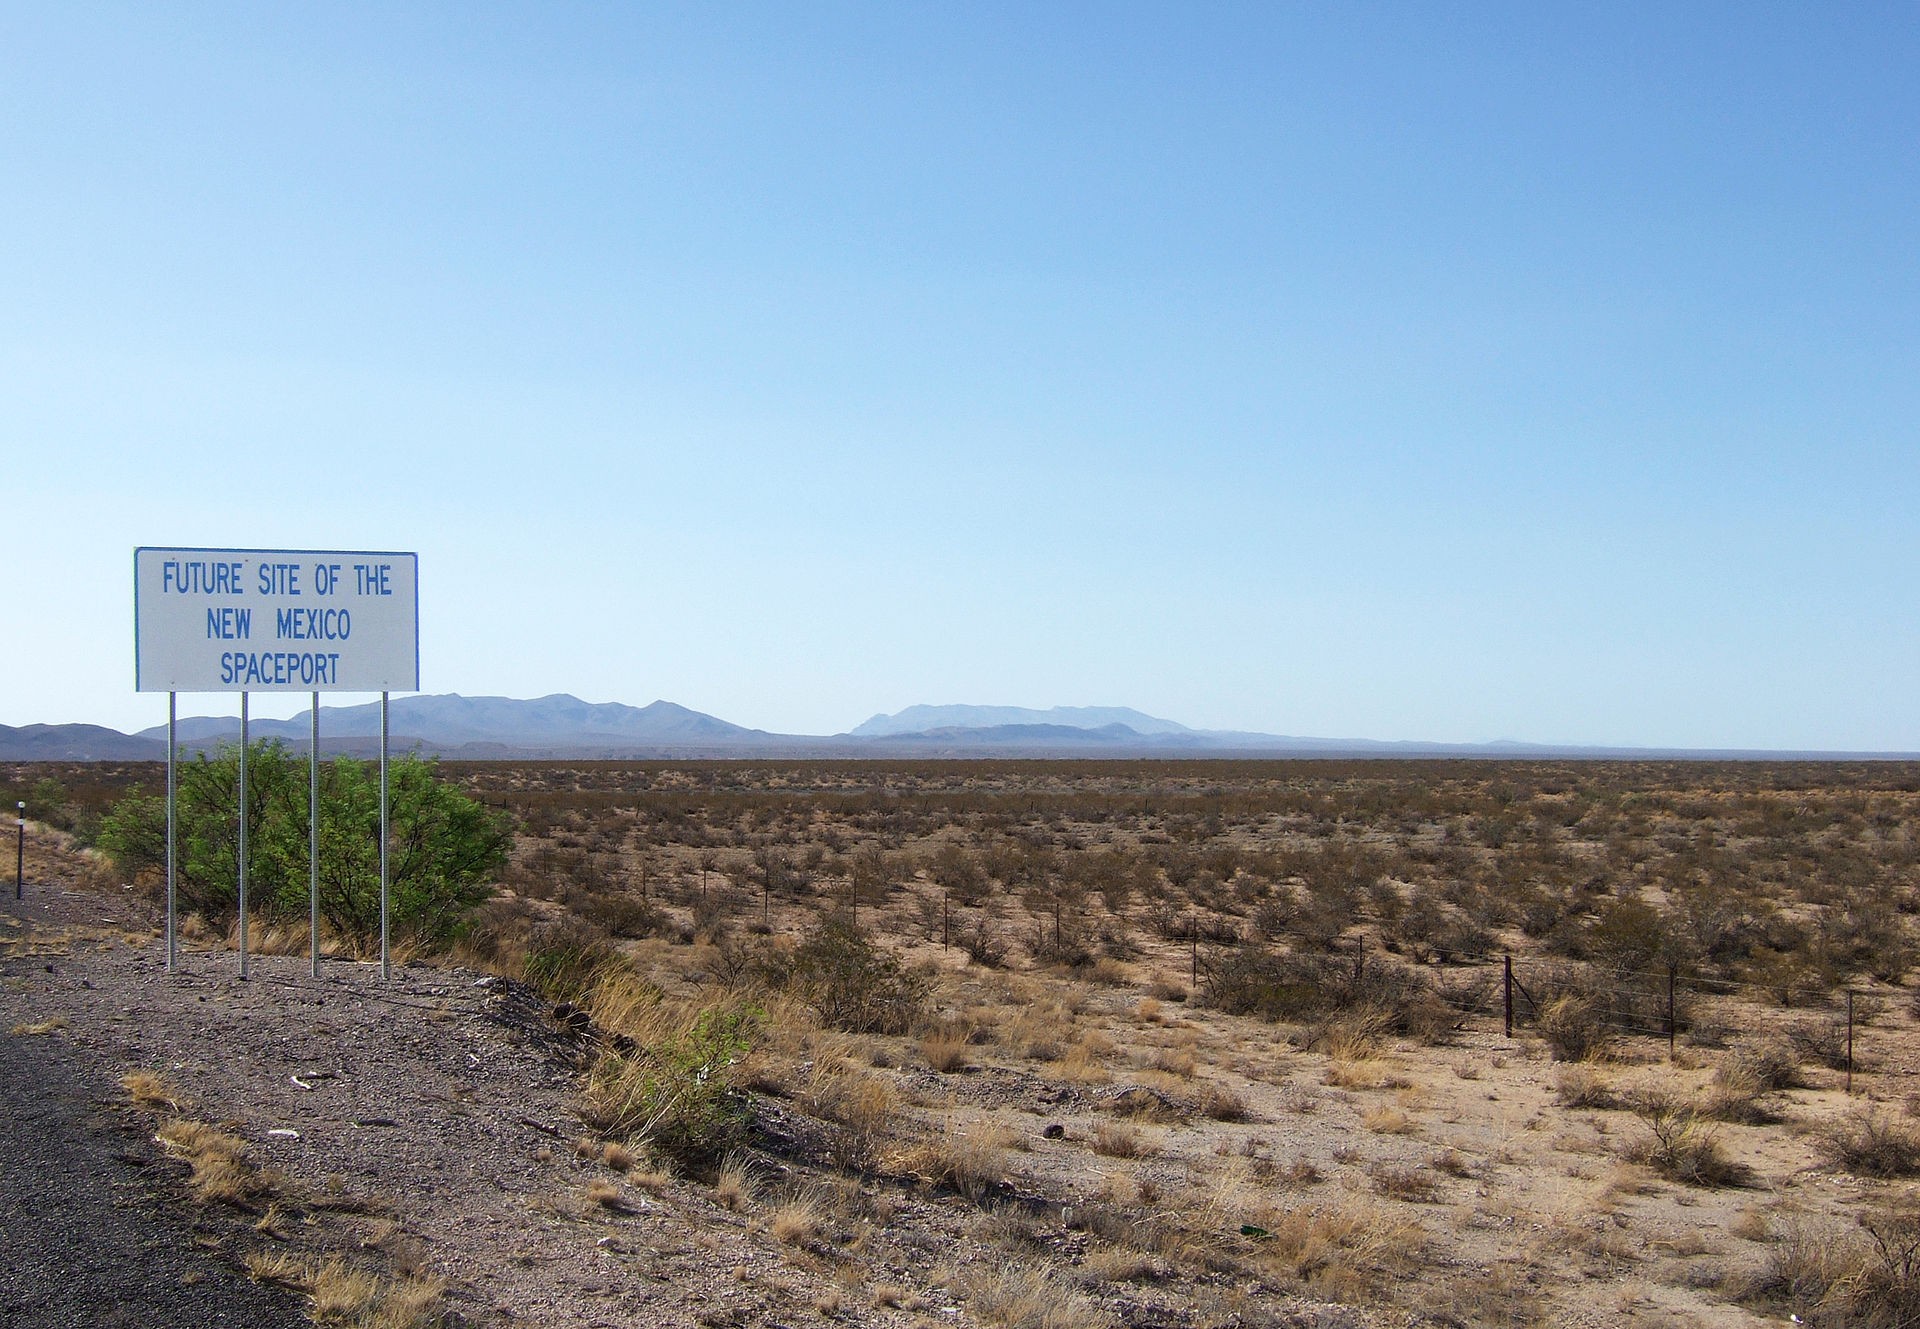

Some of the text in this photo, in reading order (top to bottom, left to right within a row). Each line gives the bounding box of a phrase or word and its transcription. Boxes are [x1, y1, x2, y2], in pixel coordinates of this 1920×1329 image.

[162, 561, 392, 595] FUTURE SITE OF THE
[207, 608, 351, 640] NEW MEXICO
[220, 652, 340, 684] SPACEPORT
